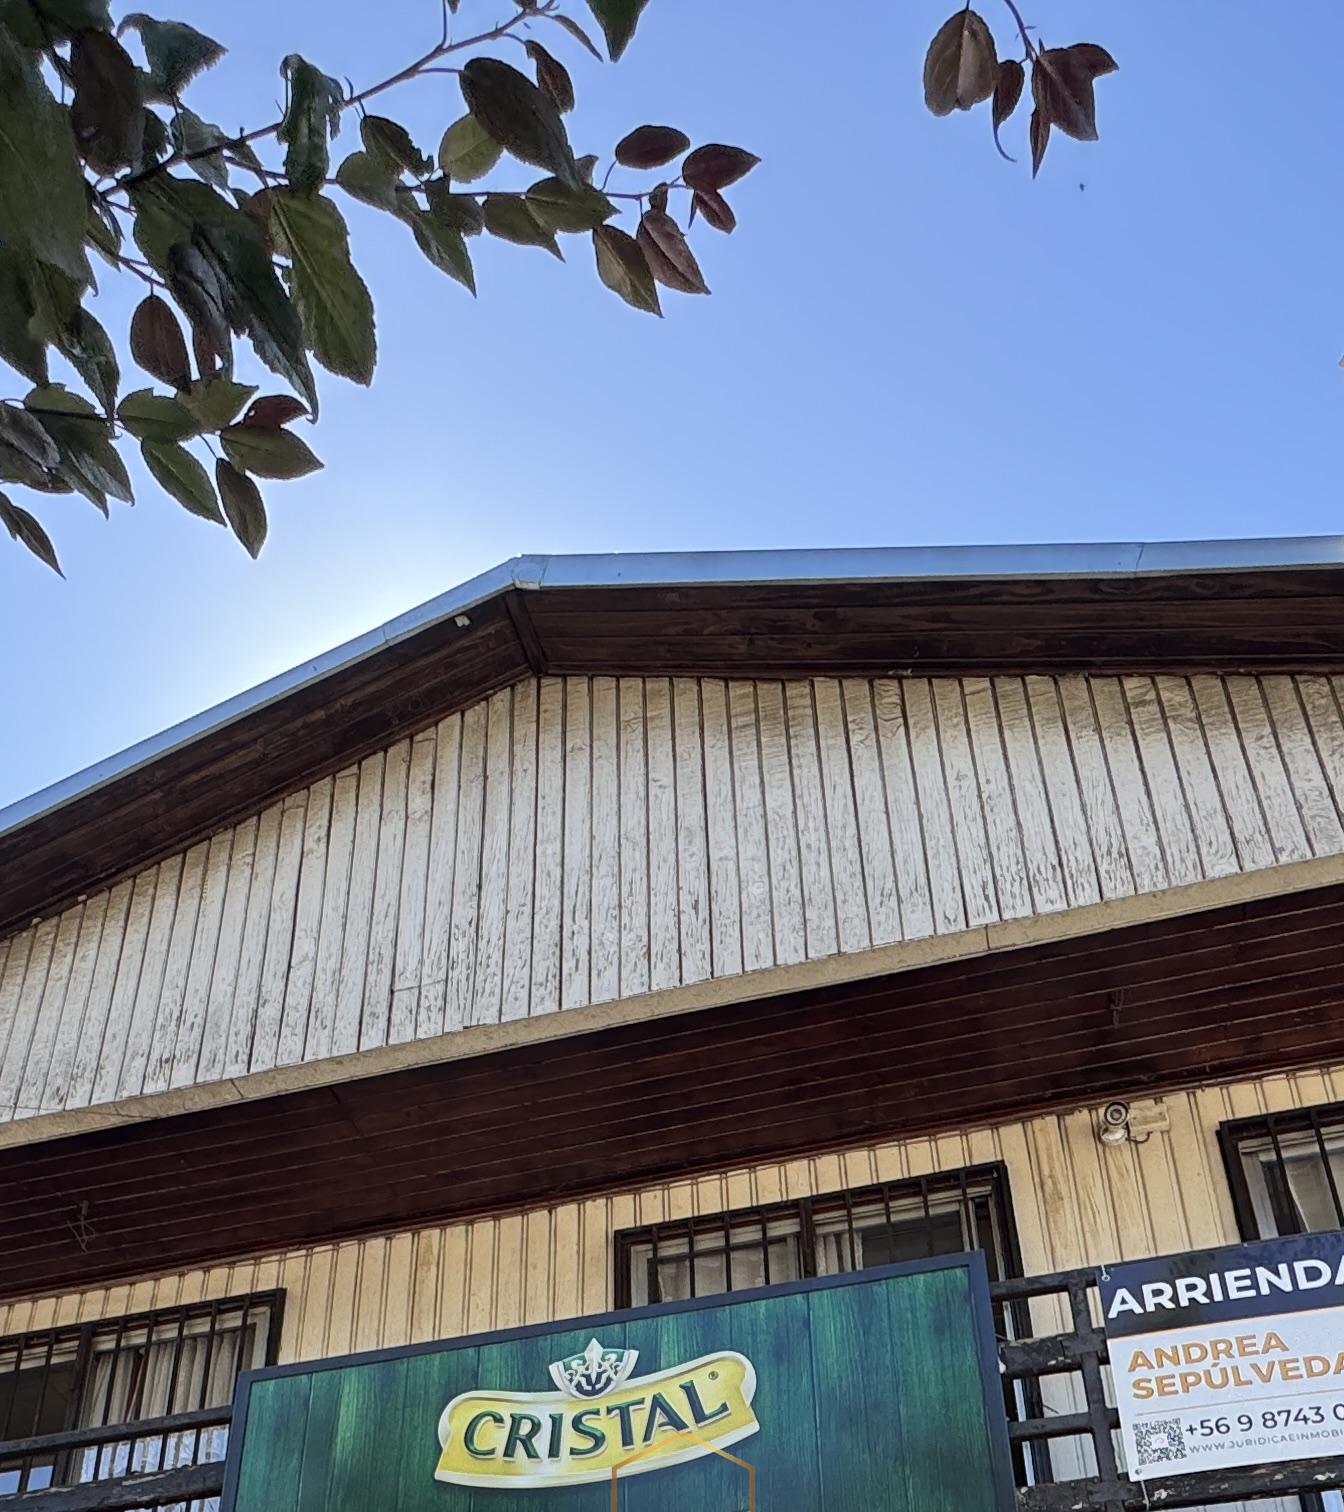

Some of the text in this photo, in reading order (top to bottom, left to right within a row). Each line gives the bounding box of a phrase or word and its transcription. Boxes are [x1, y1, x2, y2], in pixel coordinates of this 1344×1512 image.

[1128, 1332, 1290, 1373] ANDREA
[463, 1379, 731, 1461] CRISTAL
[1185, 1417, 1230, 1437] +56
[1237, 1414, 1253, 1432] 9
[1262, 1406, 1325, 1429] 8743
